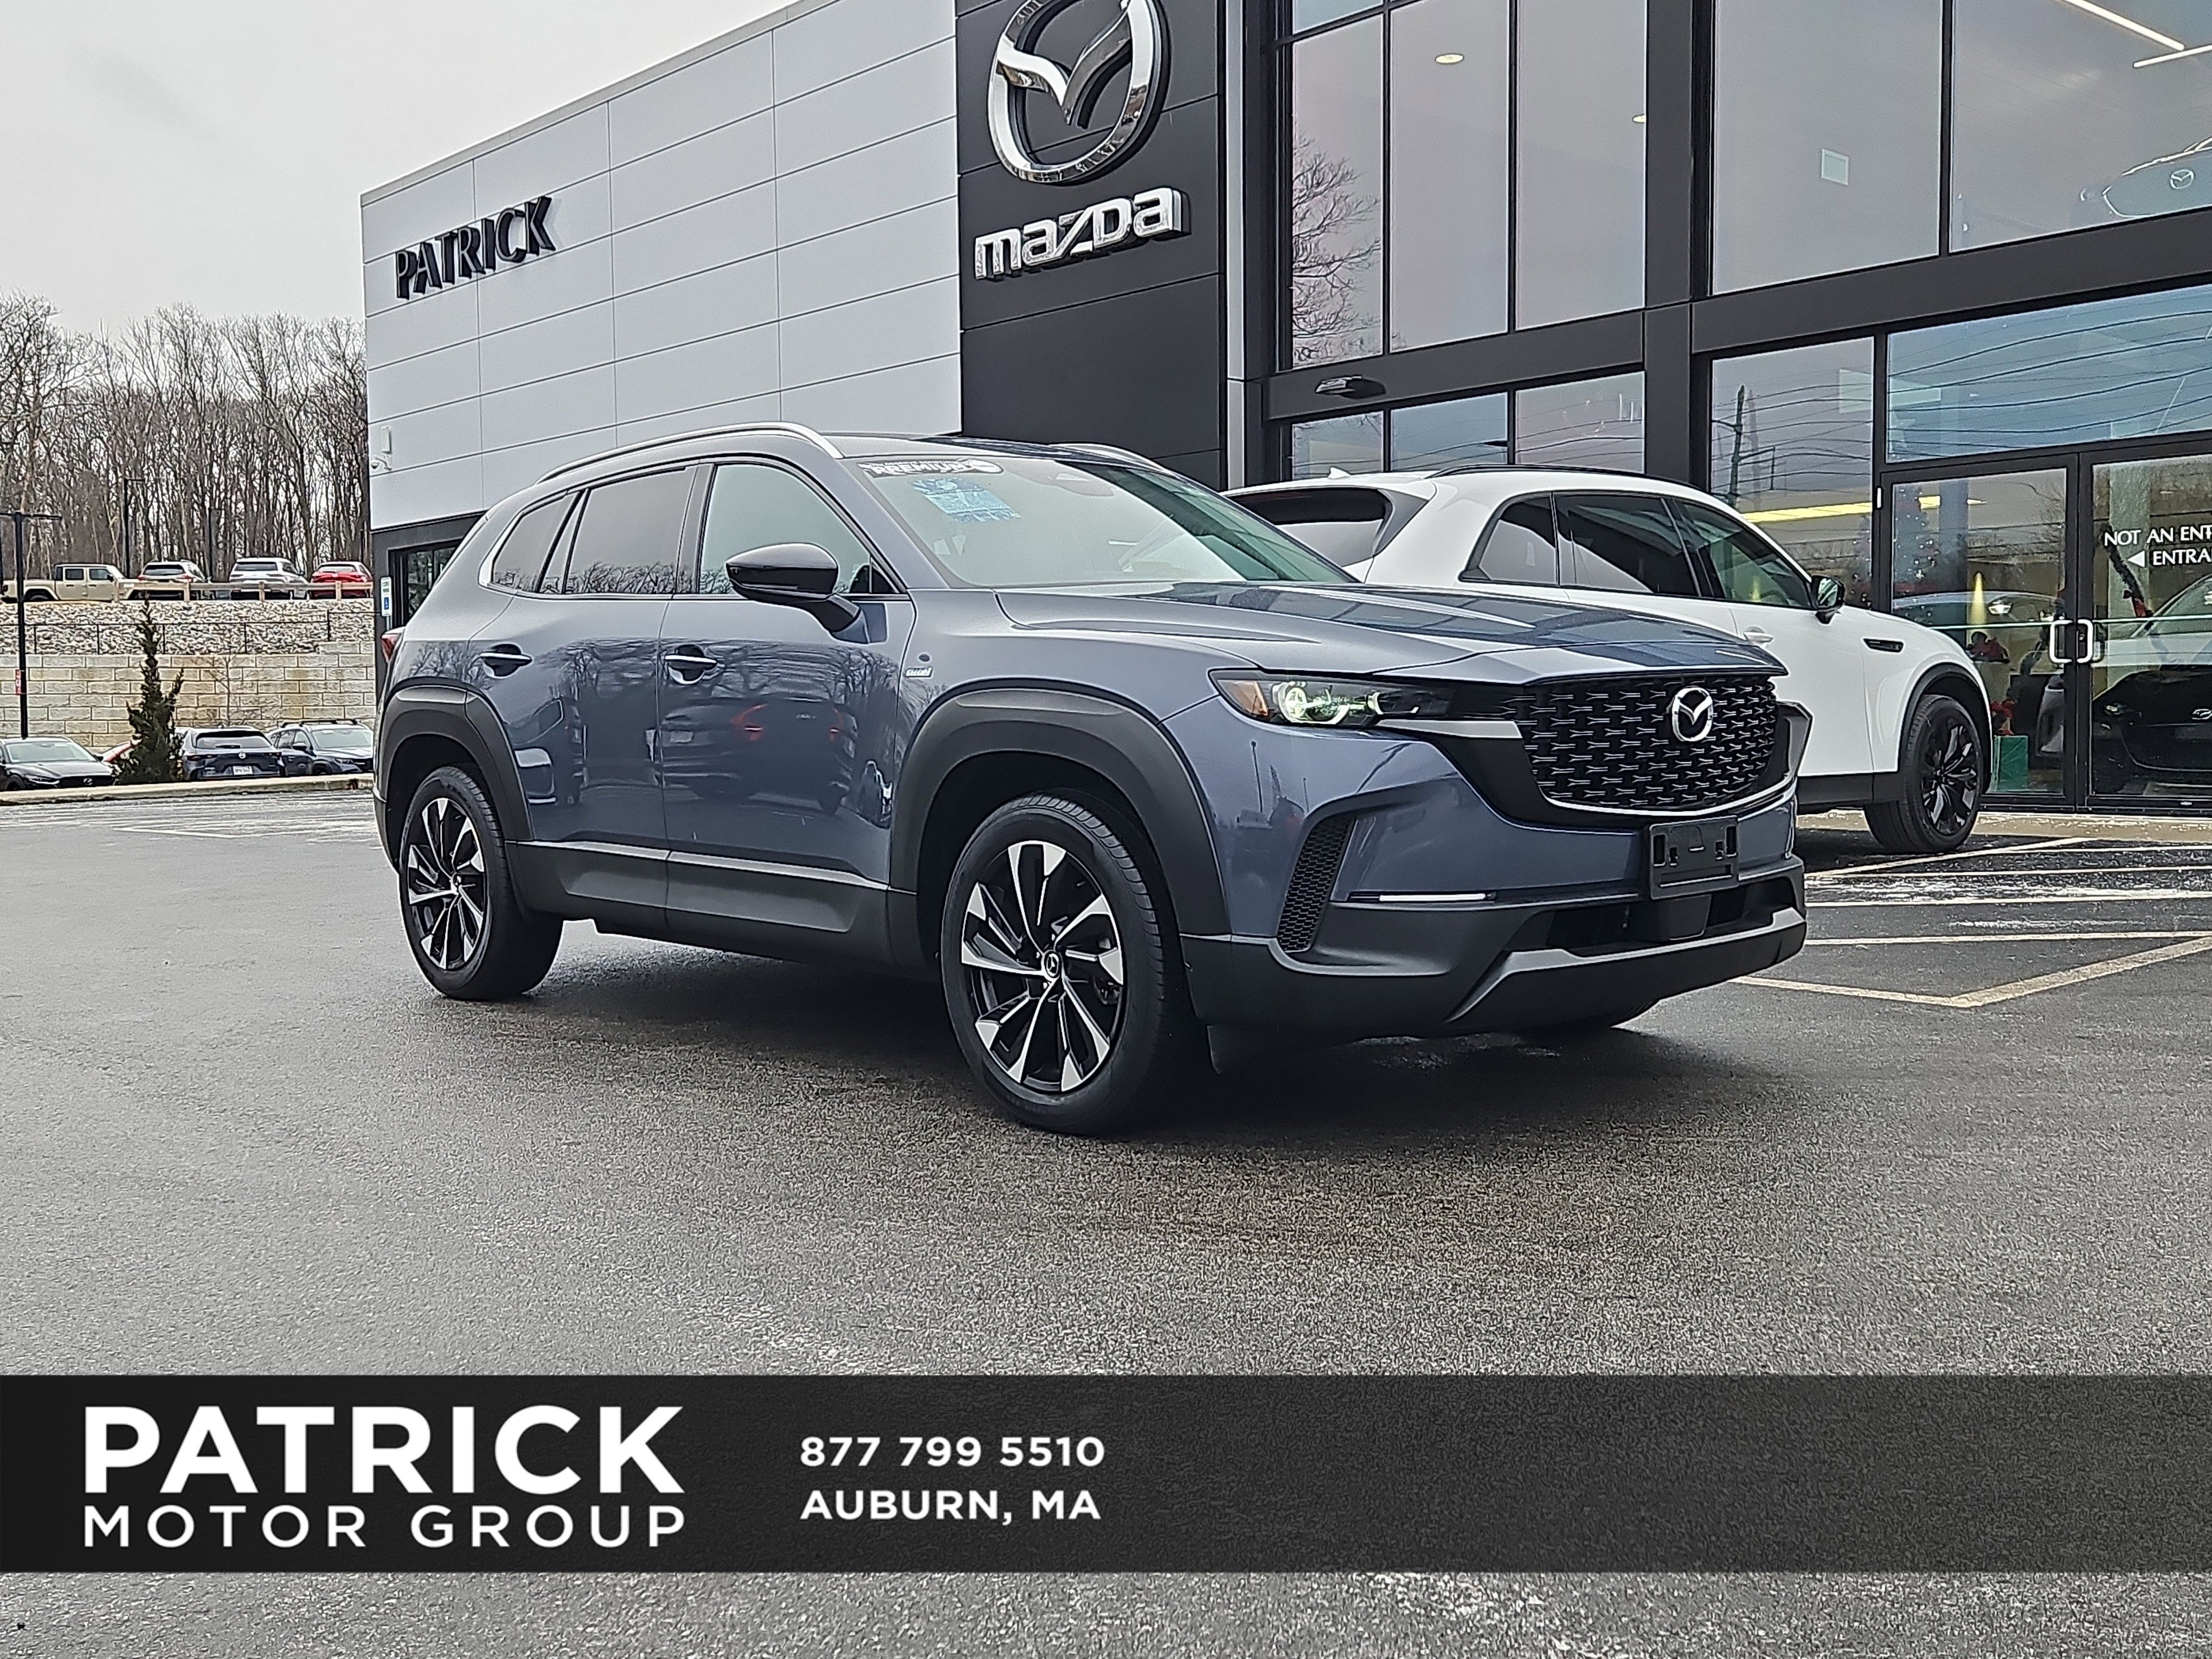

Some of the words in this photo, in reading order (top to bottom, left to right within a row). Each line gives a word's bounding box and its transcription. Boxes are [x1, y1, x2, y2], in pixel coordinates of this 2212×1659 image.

[395, 196, 556, 300] PATRICK
[2104, 529, 2142, 546] NOT
[2146, 527, 2174, 543] AN
[2153, 548, 2212, 565] ENTRA
